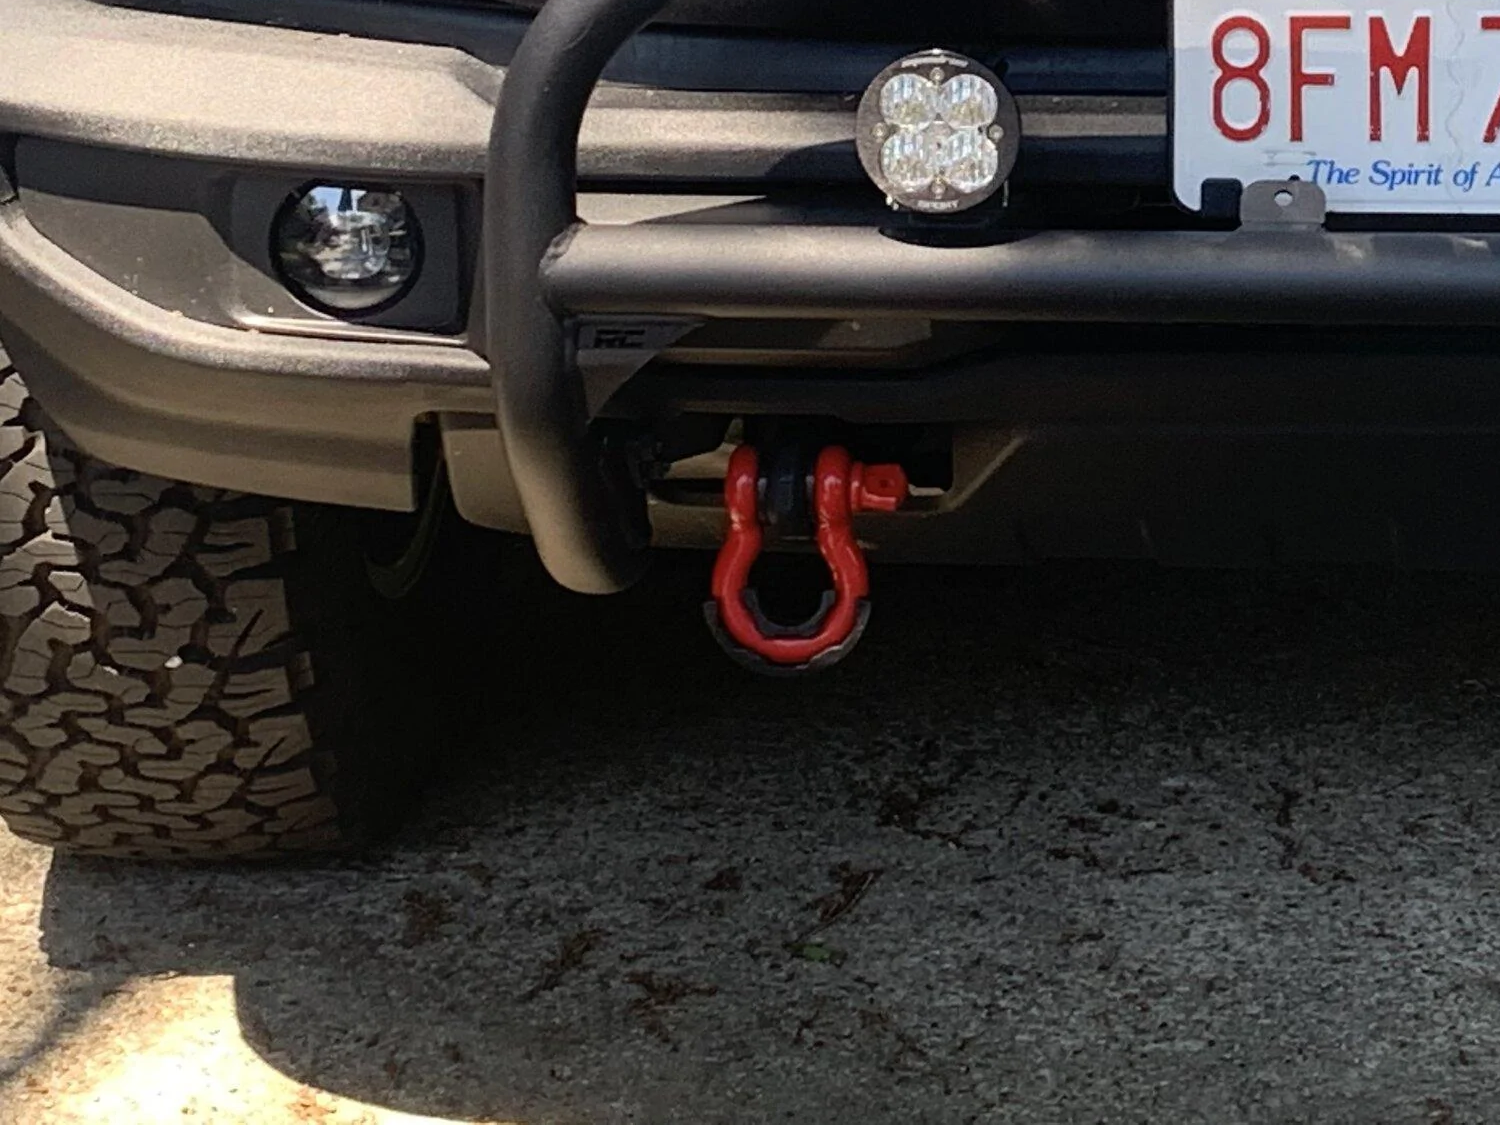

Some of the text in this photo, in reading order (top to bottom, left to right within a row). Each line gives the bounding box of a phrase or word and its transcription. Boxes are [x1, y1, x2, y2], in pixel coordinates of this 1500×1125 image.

[1210, 15, 1431, 142] 8FM
[1305, 159, 1361, 186] The
[1368, 159, 1444, 192] Spirit
[1452, 161, 1481, 193] of
